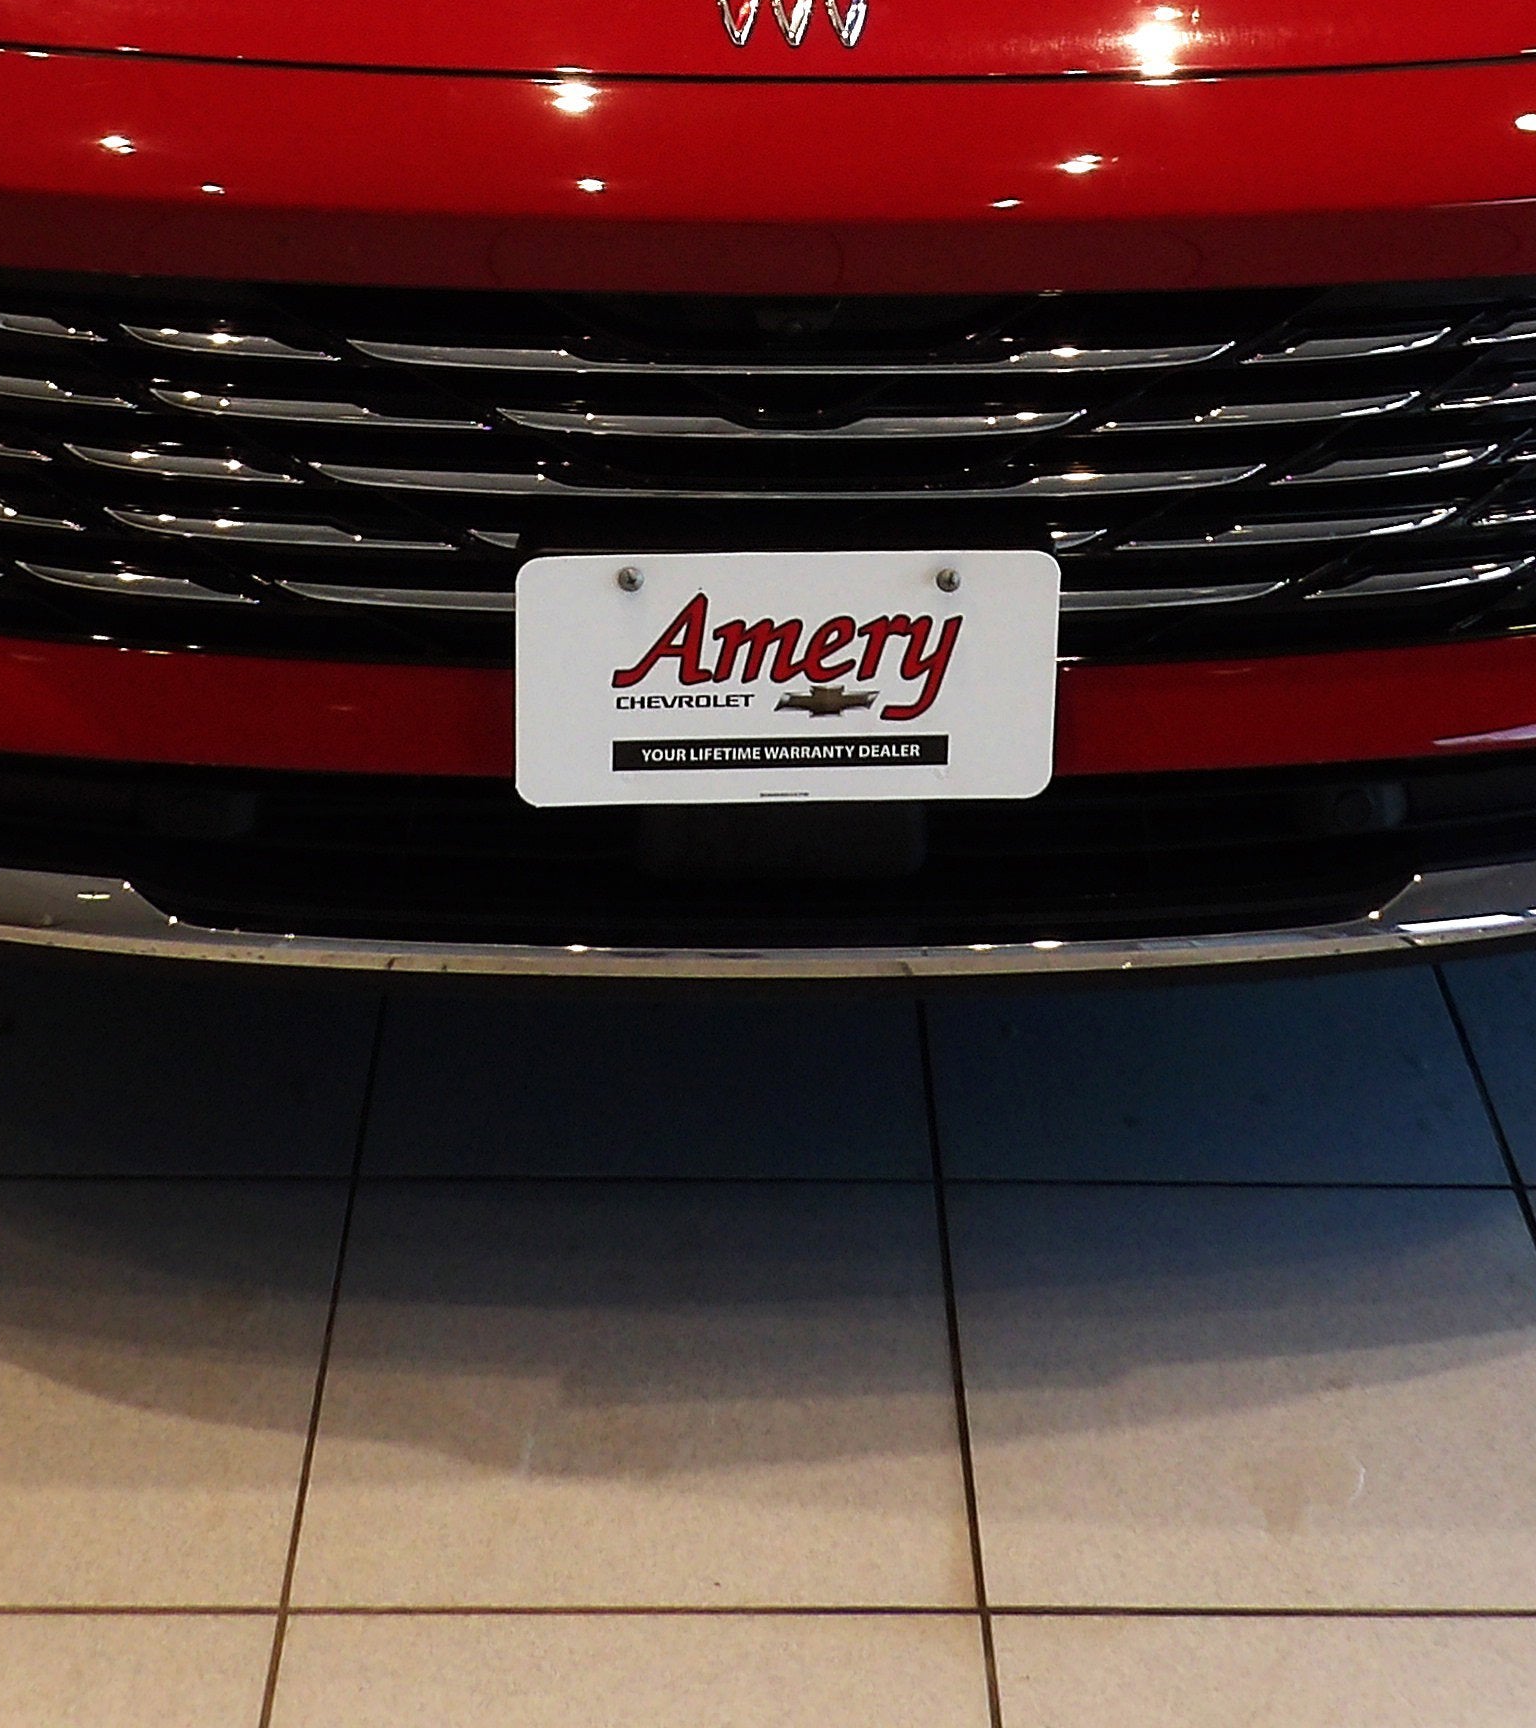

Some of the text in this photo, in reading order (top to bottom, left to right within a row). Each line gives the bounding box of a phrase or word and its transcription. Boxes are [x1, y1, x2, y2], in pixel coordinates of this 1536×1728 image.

[611, 592, 964, 721] Amery
[615, 694, 755, 710] CHEVROLET
[641, 743, 921, 763] YOUR LIFETIME WARRANTY DEALER
